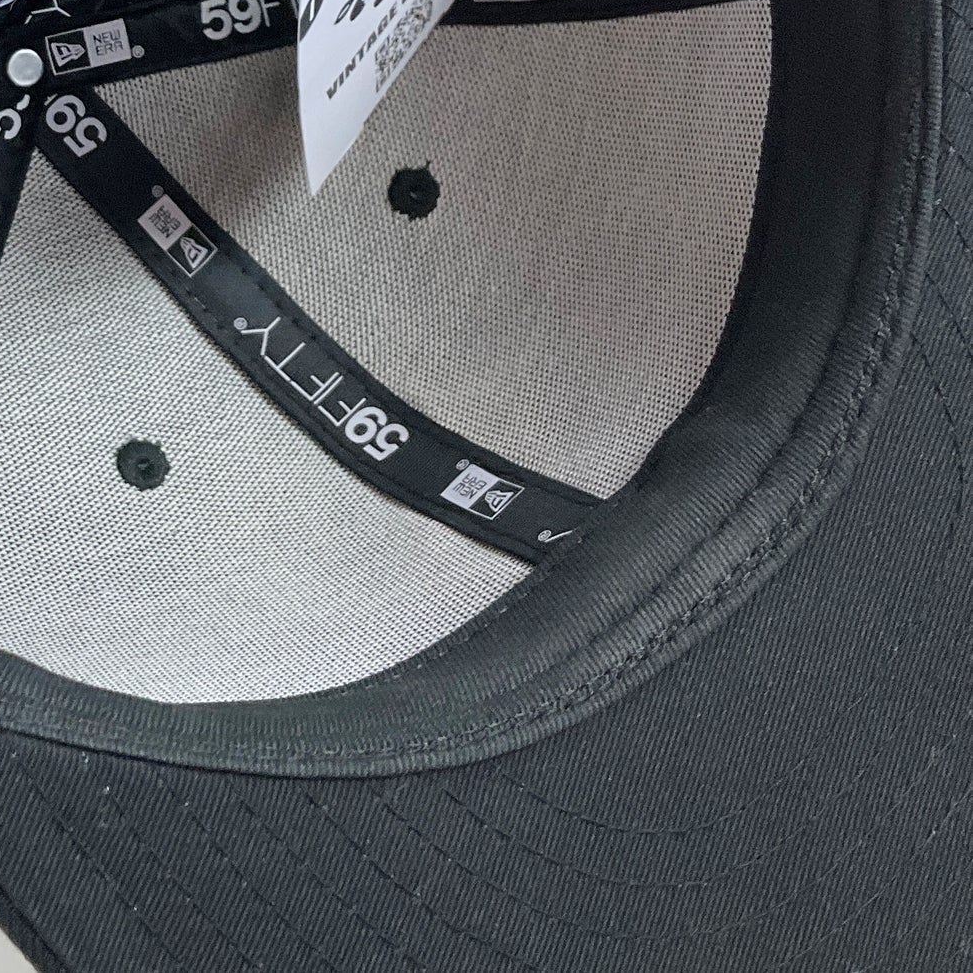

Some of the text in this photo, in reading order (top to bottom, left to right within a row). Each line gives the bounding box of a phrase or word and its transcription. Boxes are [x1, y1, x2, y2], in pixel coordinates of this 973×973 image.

[93, 29, 121, 43] NEW
[96, 41, 123, 56] ERA
[327, 1, 398, 99] VINTAGE
